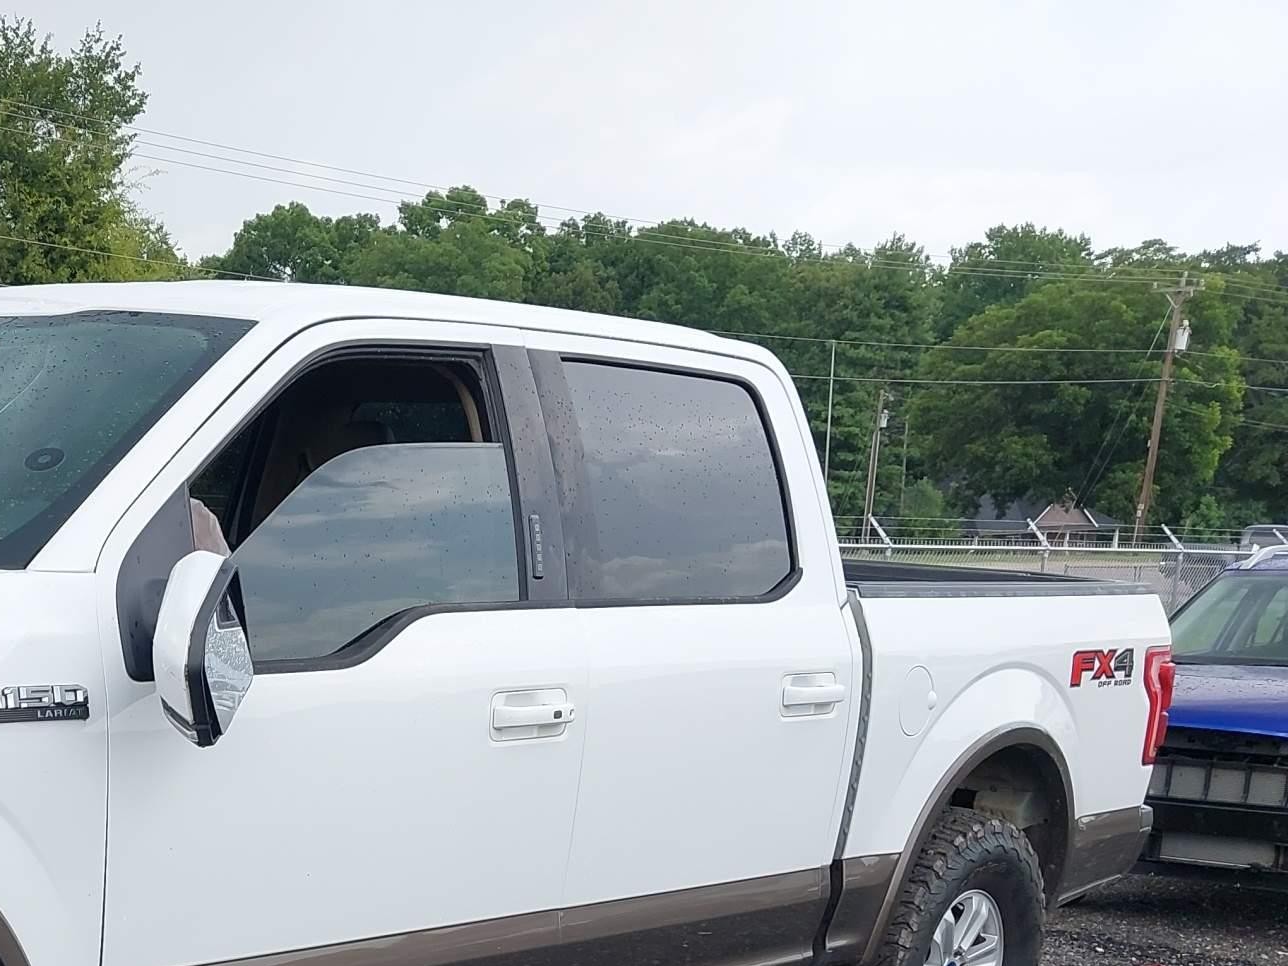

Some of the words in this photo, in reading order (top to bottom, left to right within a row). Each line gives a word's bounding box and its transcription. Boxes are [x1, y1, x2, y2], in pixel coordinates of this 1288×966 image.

[1070, 648, 1134, 688] FX4
[1098, 680, 1112, 688] OFF
[1114, 679, 1132, 687] ROAD
[37, 708, 84, 719] LARIAT
